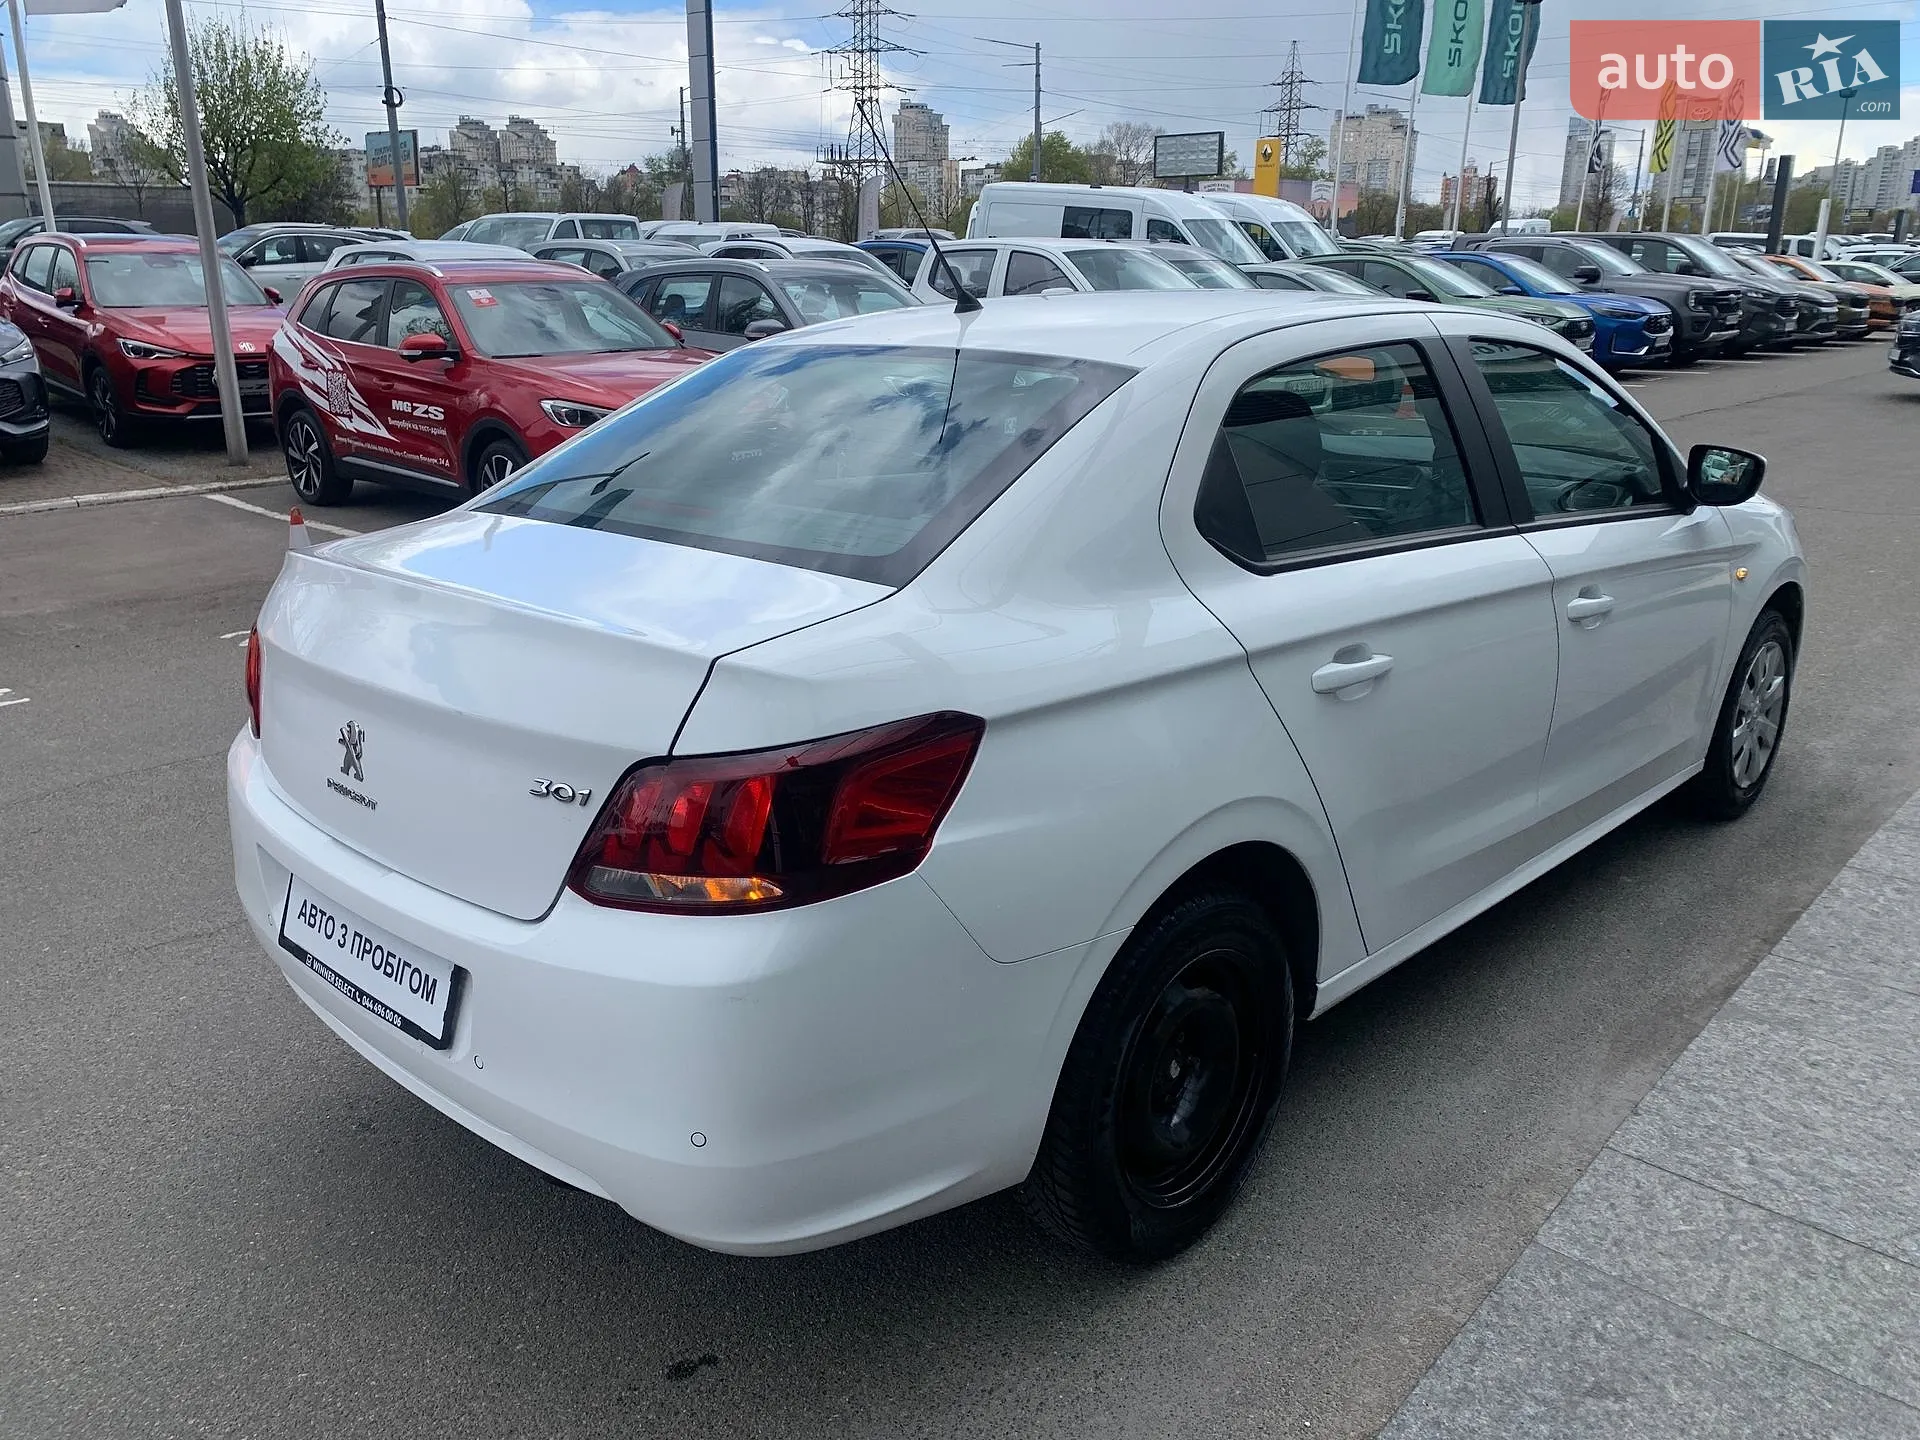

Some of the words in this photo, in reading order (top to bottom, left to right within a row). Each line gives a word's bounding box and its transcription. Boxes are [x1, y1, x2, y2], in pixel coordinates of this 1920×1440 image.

[391, 399, 412, 413] MG
[412, 402, 445, 421] ZS
[528, 777, 592, 807] 301
[297, 899, 336, 940] АВТО
[349, 930, 438, 1005] ПРОБІГОМ
[313, 959, 336, 985] WINNER
[334, 977, 355, 998] SELECT
[361, 995, 373, 1010] 044
[373, 1004, 385, 1017] 496
[385, 1009, 394, 1021] 00
